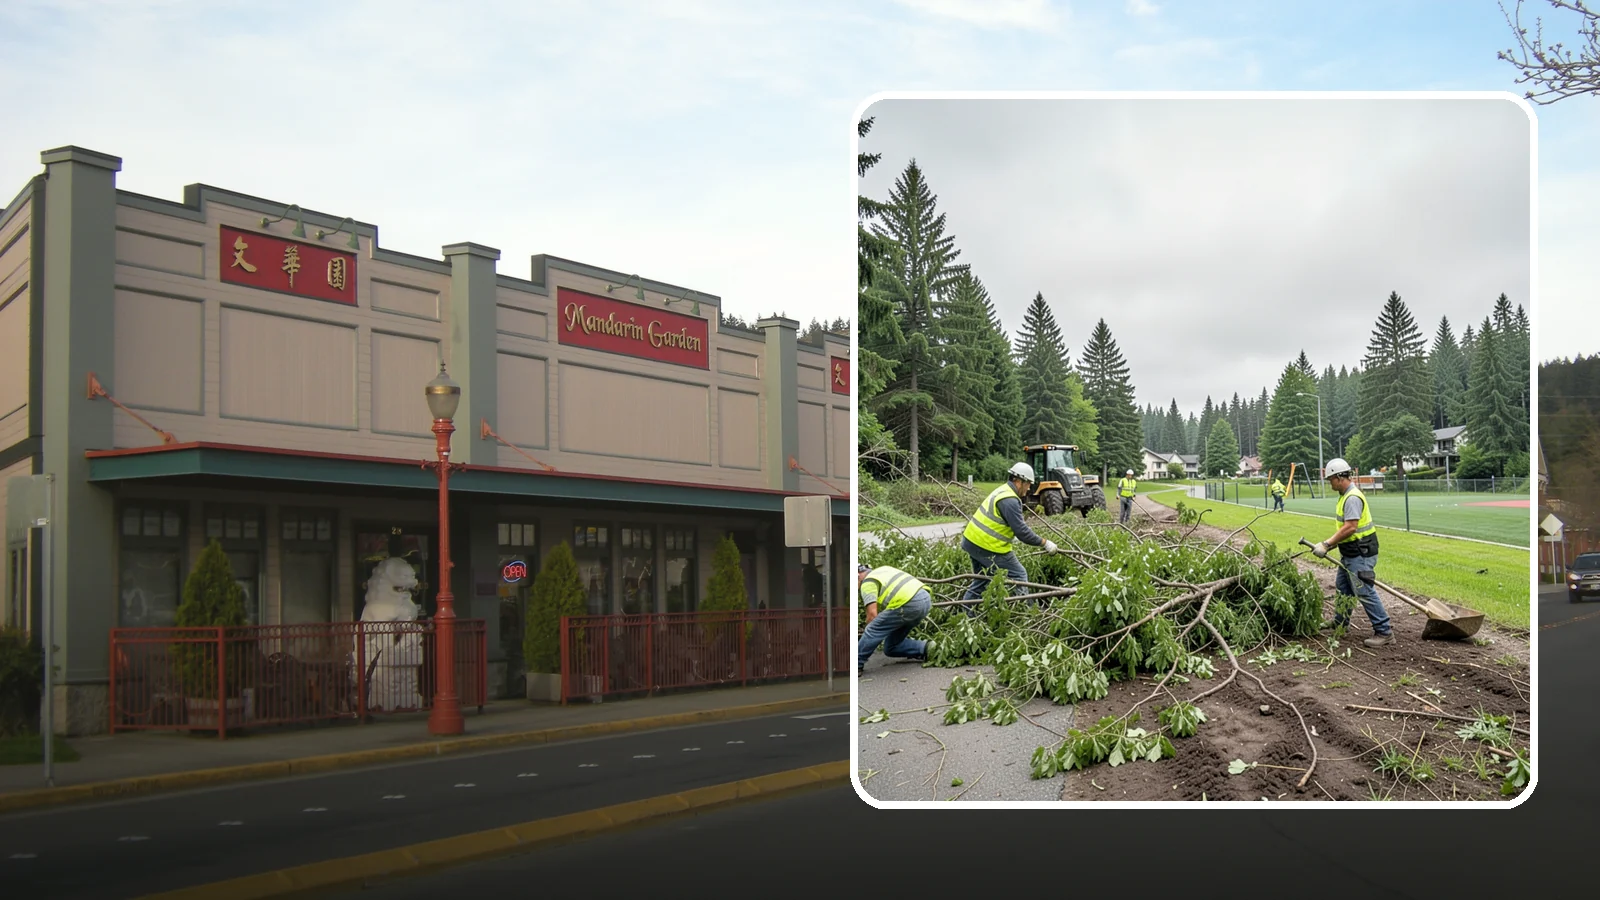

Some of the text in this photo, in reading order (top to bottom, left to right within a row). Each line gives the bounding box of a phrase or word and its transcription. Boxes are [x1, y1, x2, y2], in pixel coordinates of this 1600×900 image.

[231, 235, 346, 290] 文華園
[564, 302, 701, 352] Mandarin Garden
[503, 565, 527, 578] OPEN
